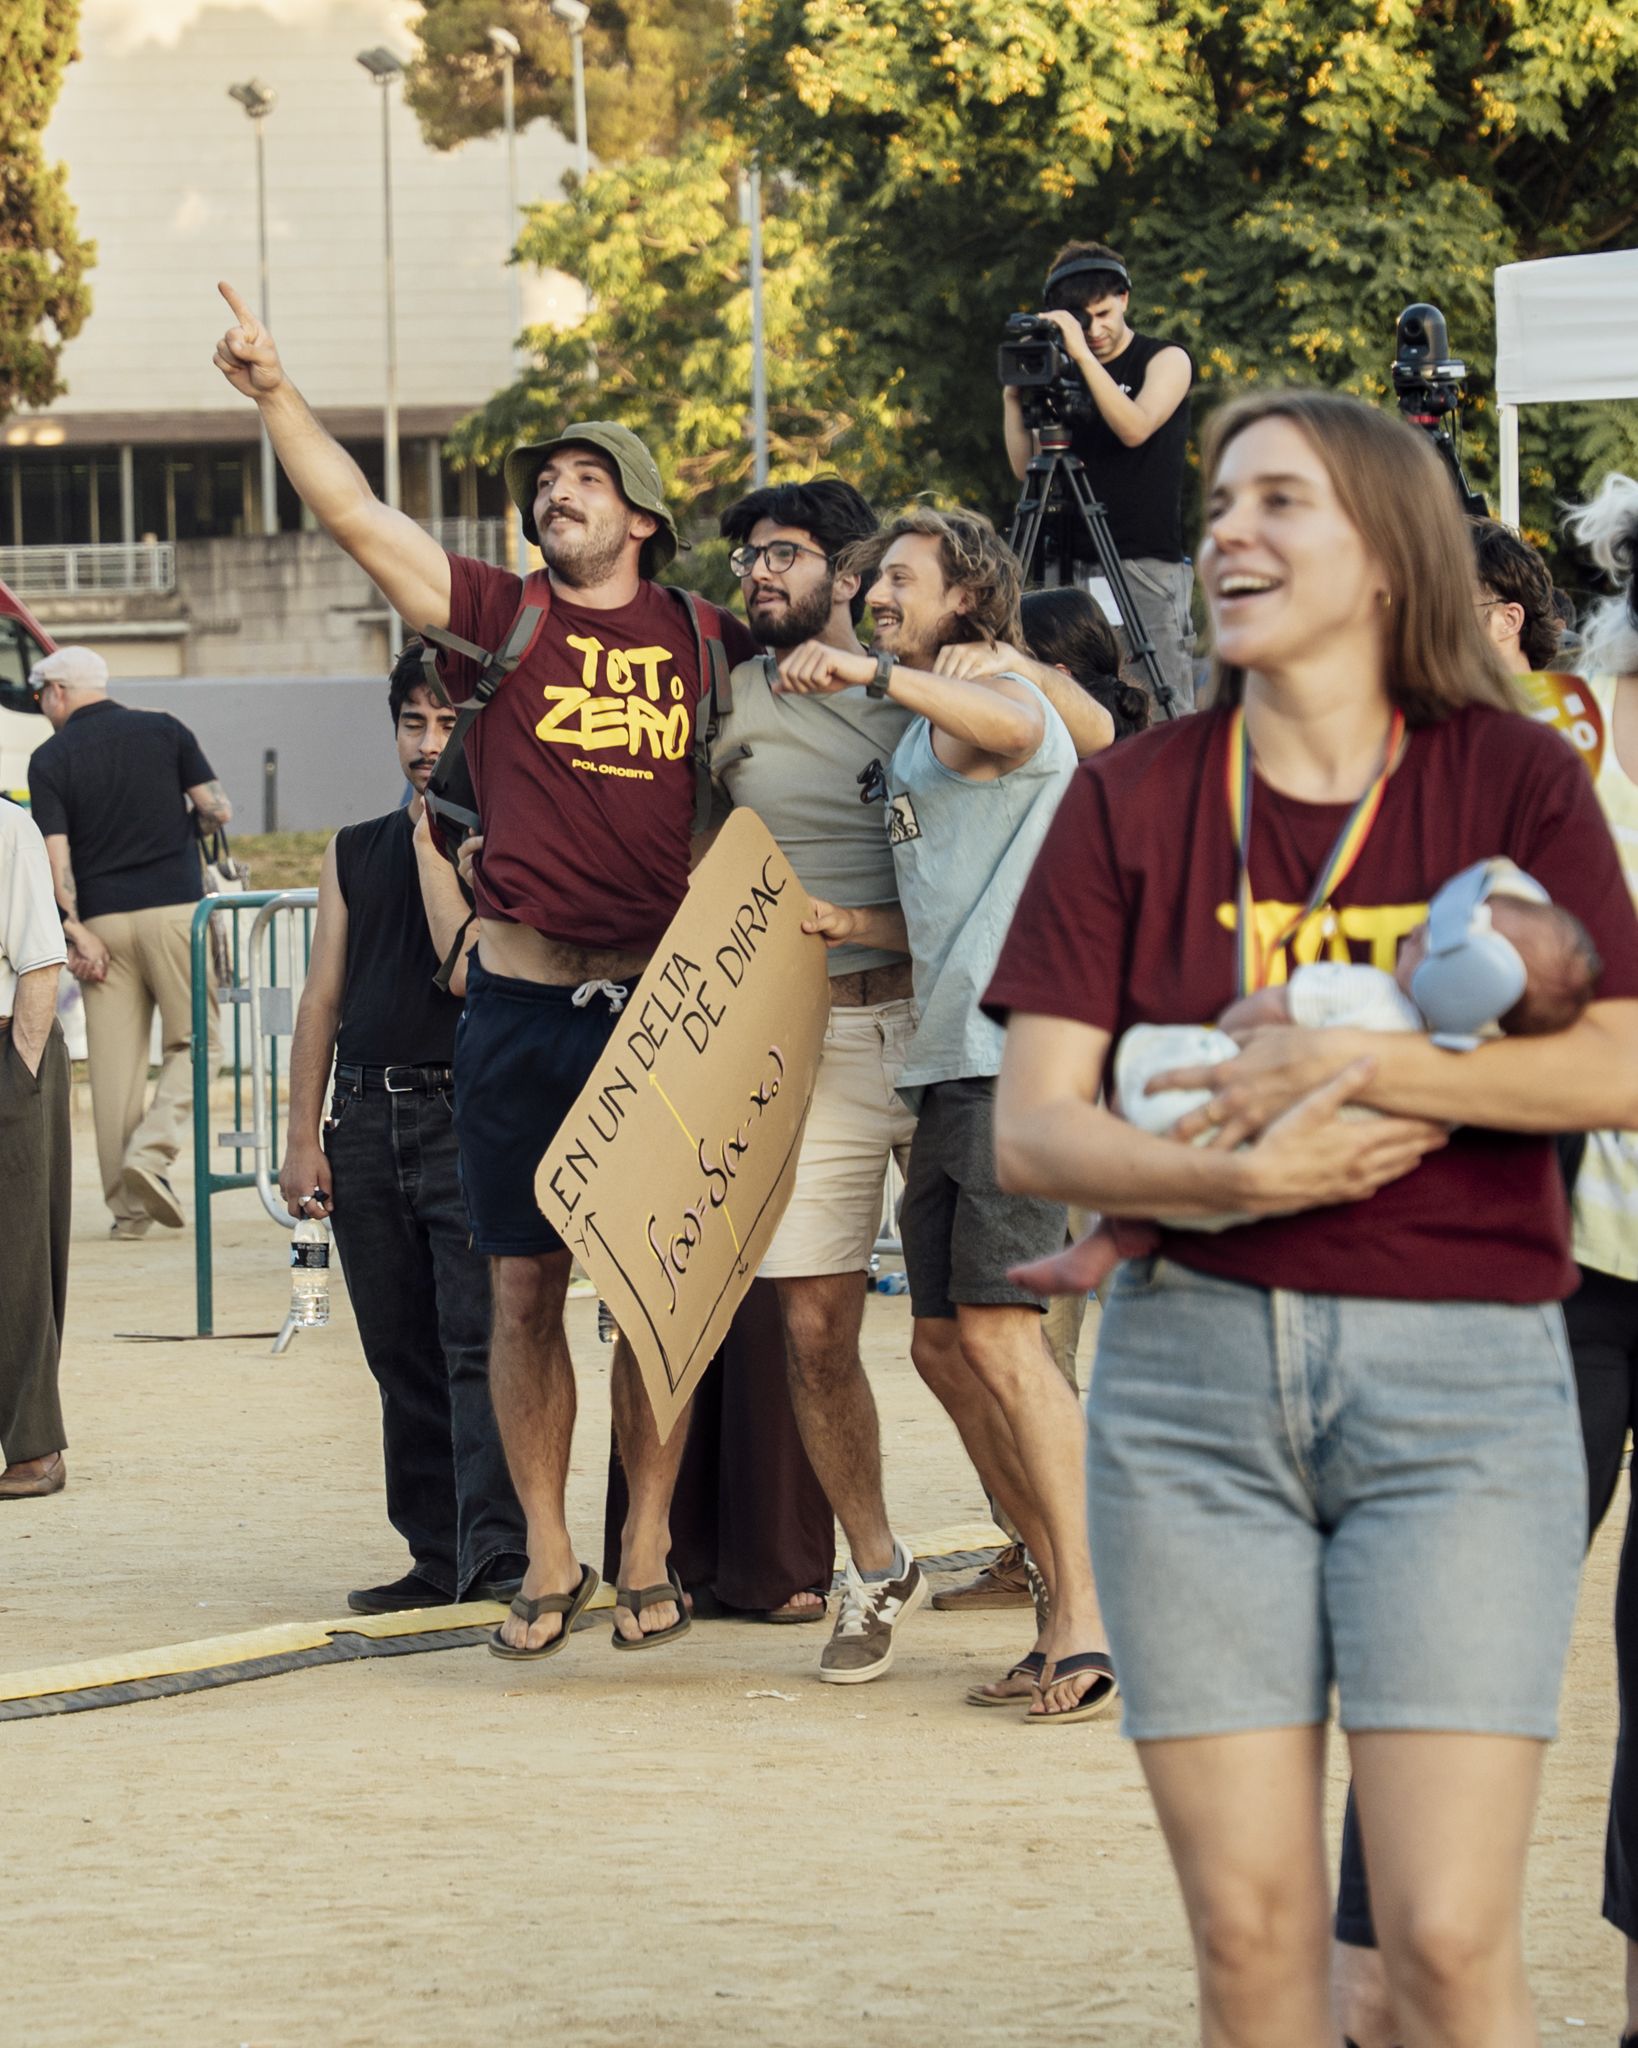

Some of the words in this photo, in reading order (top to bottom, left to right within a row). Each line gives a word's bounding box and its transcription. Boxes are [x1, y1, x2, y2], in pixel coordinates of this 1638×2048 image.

[566, 634, 673, 701] TOT
[535, 685, 689, 761] ZERO
[572, 759, 597, 772] POL
[682, 980, 727, 1054] DE
[716, 855, 787, 988] DIRAC
[588, 1066, 637, 1142] UN
[627, 952, 702, 1072] DELTA
